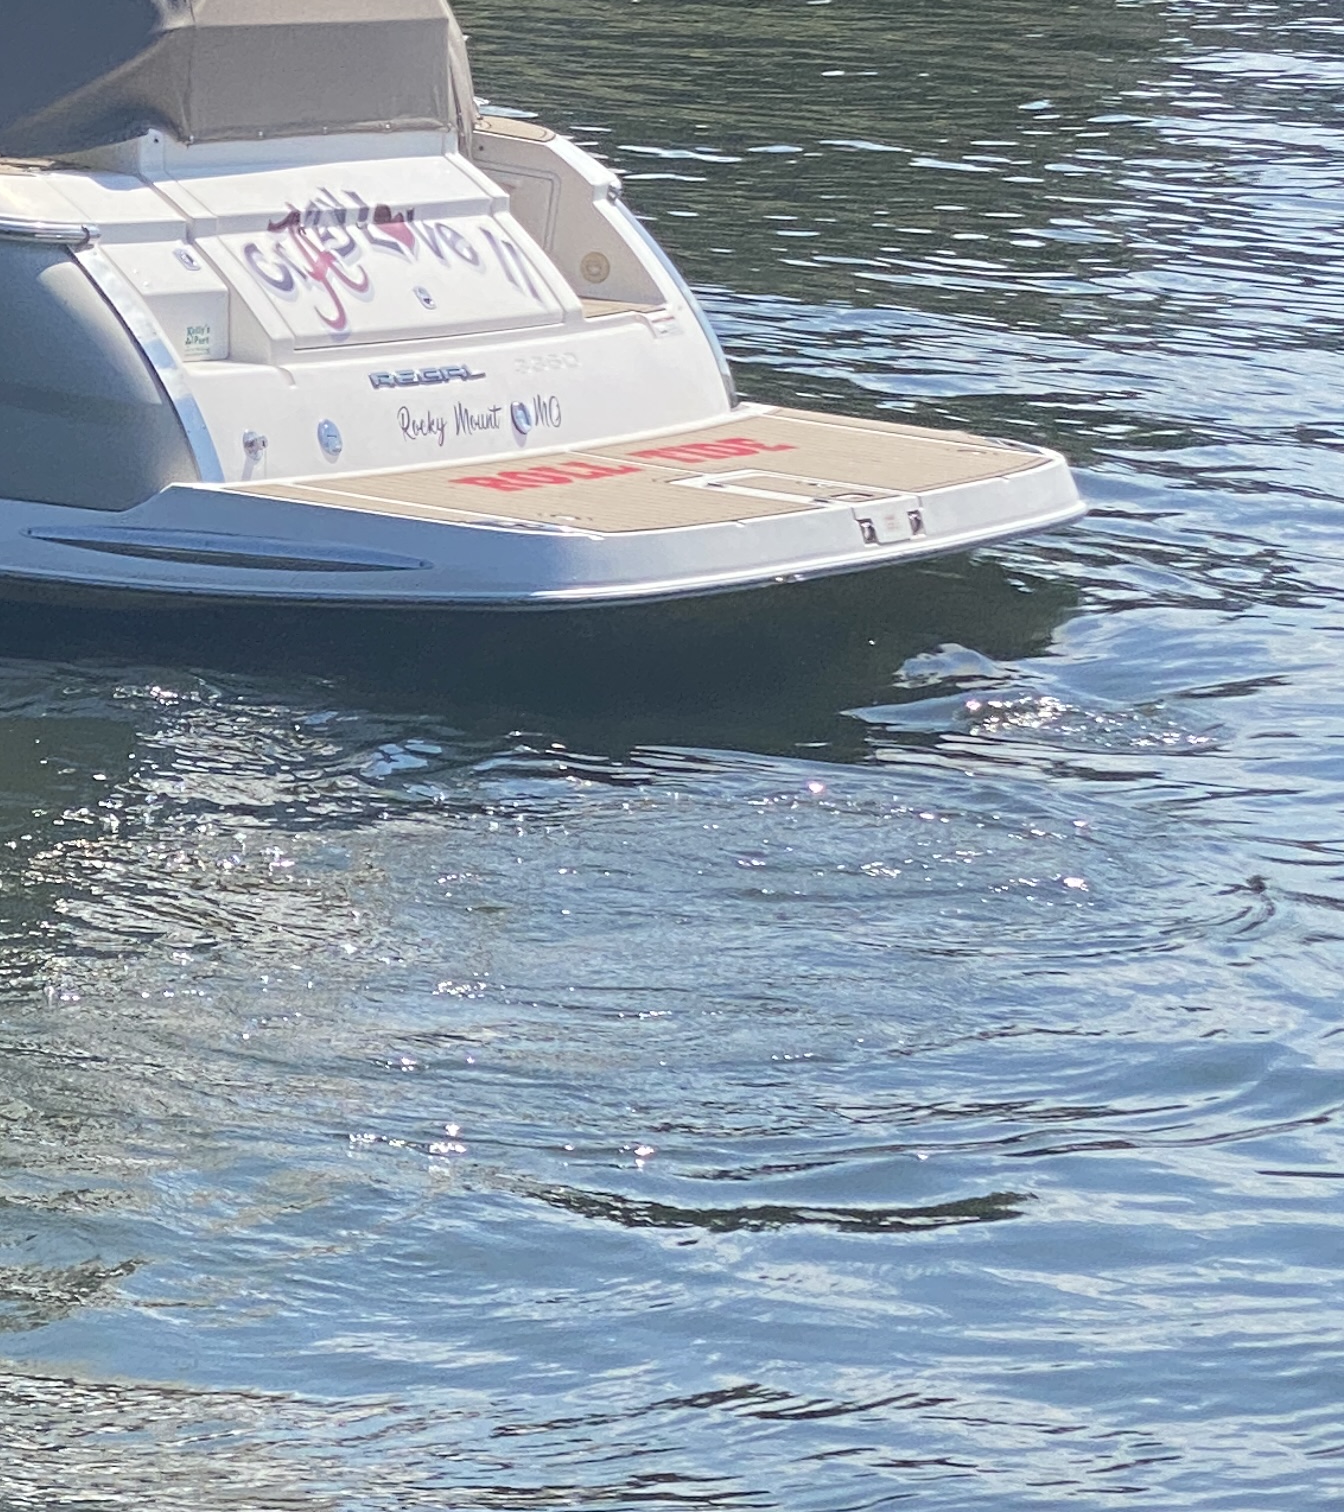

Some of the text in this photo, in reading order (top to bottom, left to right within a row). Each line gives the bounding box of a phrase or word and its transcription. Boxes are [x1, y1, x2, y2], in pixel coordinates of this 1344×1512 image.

[368, 364, 487, 389] REGAL
[396, 394, 562, 447] Rocky Mount MO
[448, 437, 799, 492] ROLL TIDE
